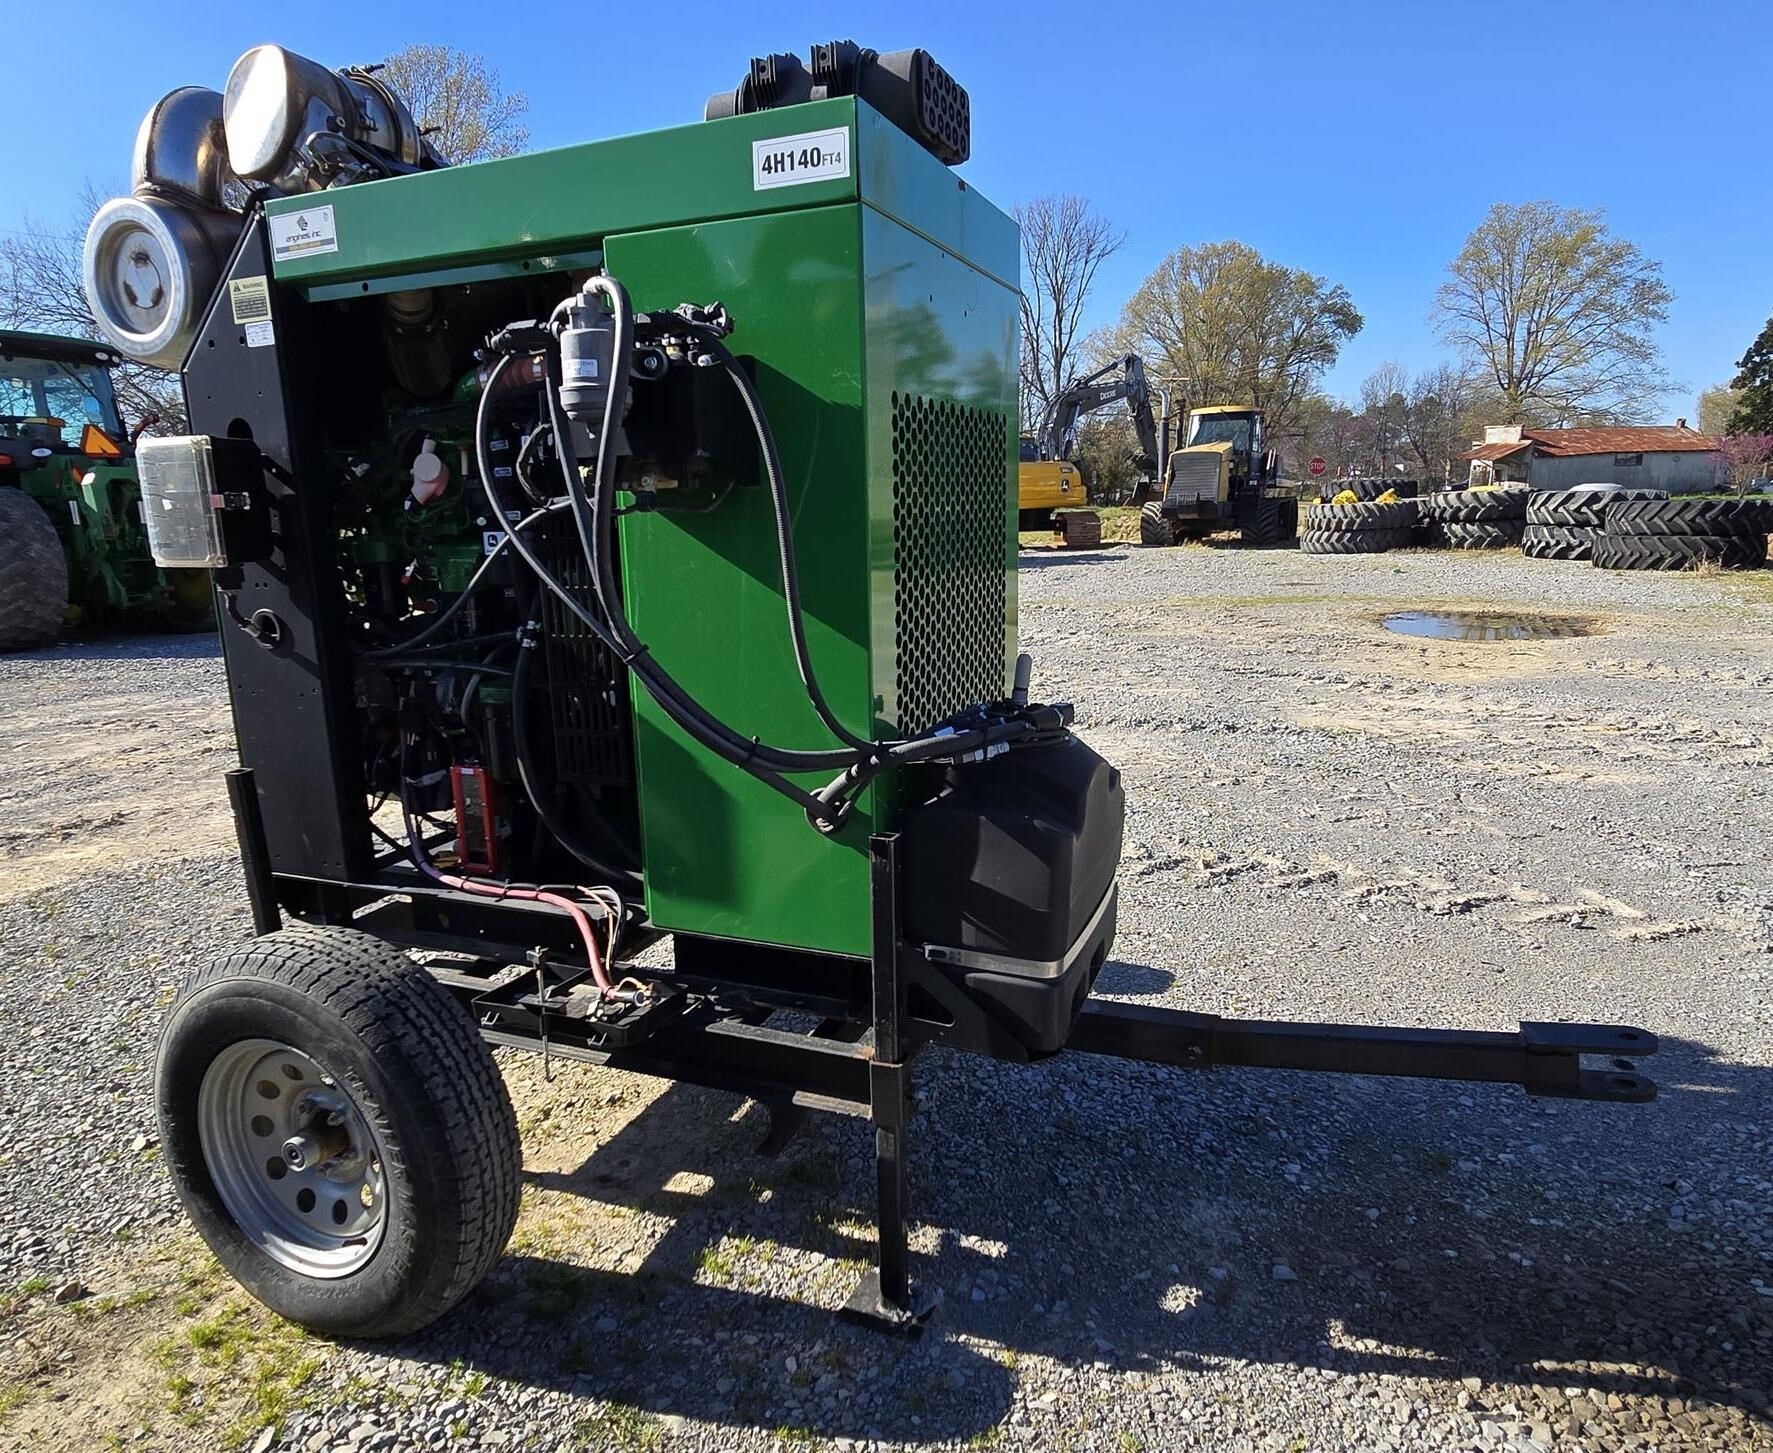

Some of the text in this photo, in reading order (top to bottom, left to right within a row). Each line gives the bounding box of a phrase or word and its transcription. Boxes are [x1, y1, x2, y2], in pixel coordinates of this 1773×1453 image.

[286, 233, 310, 243] engines
[1310, 462, 1325, 470] STOP
[343, 1064, 407, 1178] TRAILER
